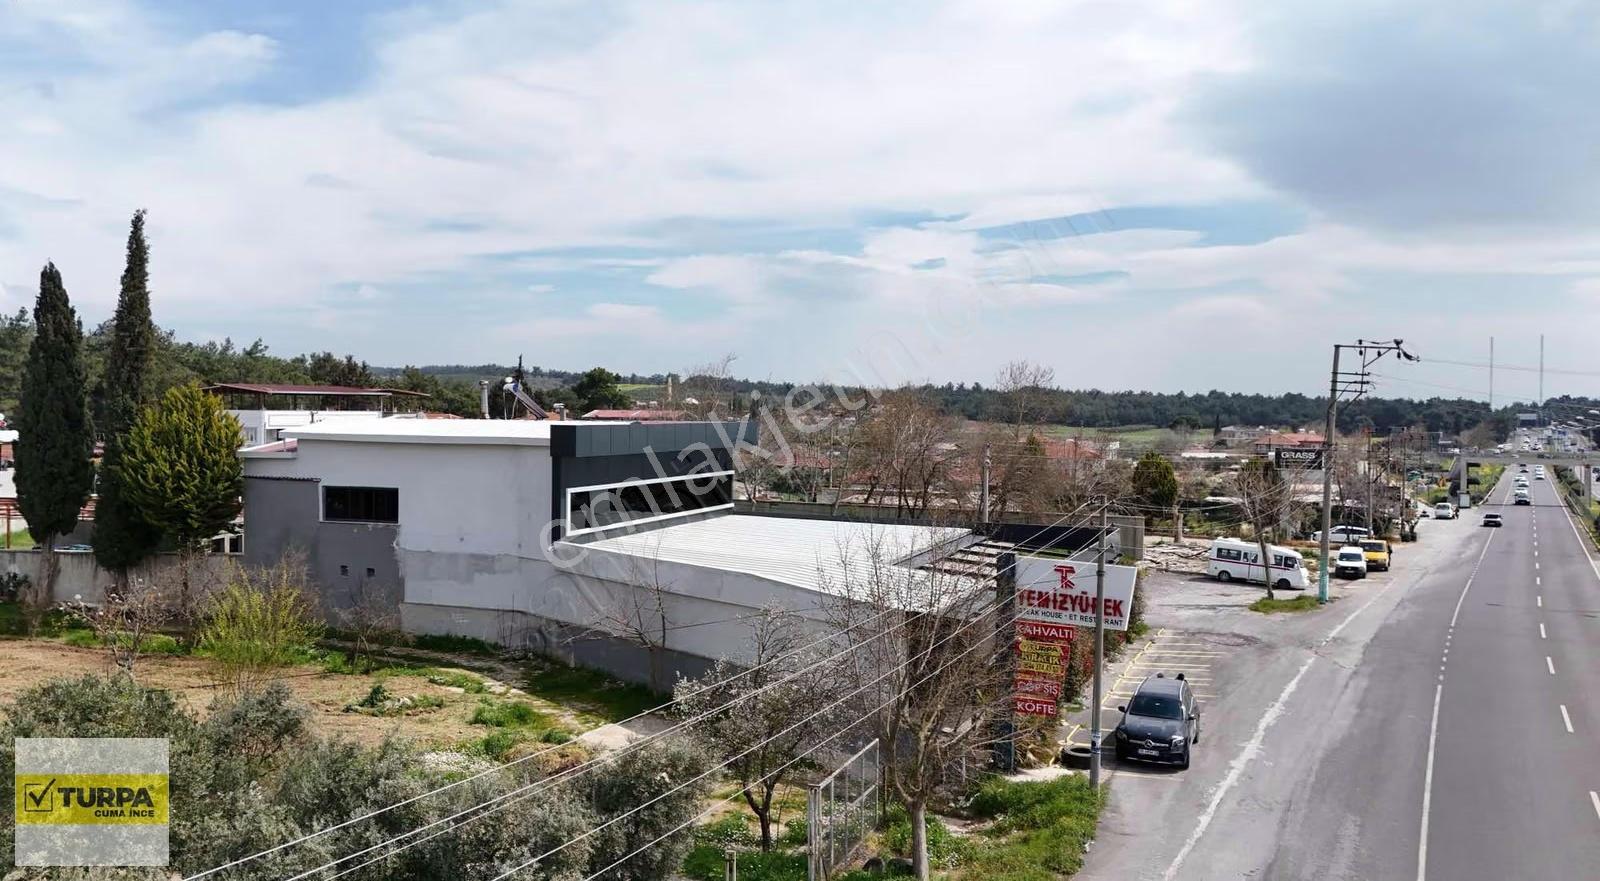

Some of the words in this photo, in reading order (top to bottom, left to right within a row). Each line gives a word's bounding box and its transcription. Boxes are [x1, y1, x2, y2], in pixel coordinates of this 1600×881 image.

[1281, 451, 1315, 460] GRASS
[1042, 611, 1062, 619] HOUSE
[1080, 615, 1123, 626] RESTRANT
[1016, 625, 1073, 639] KAHVALTI
[1017, 700, 1056, 714] KÖFTE
